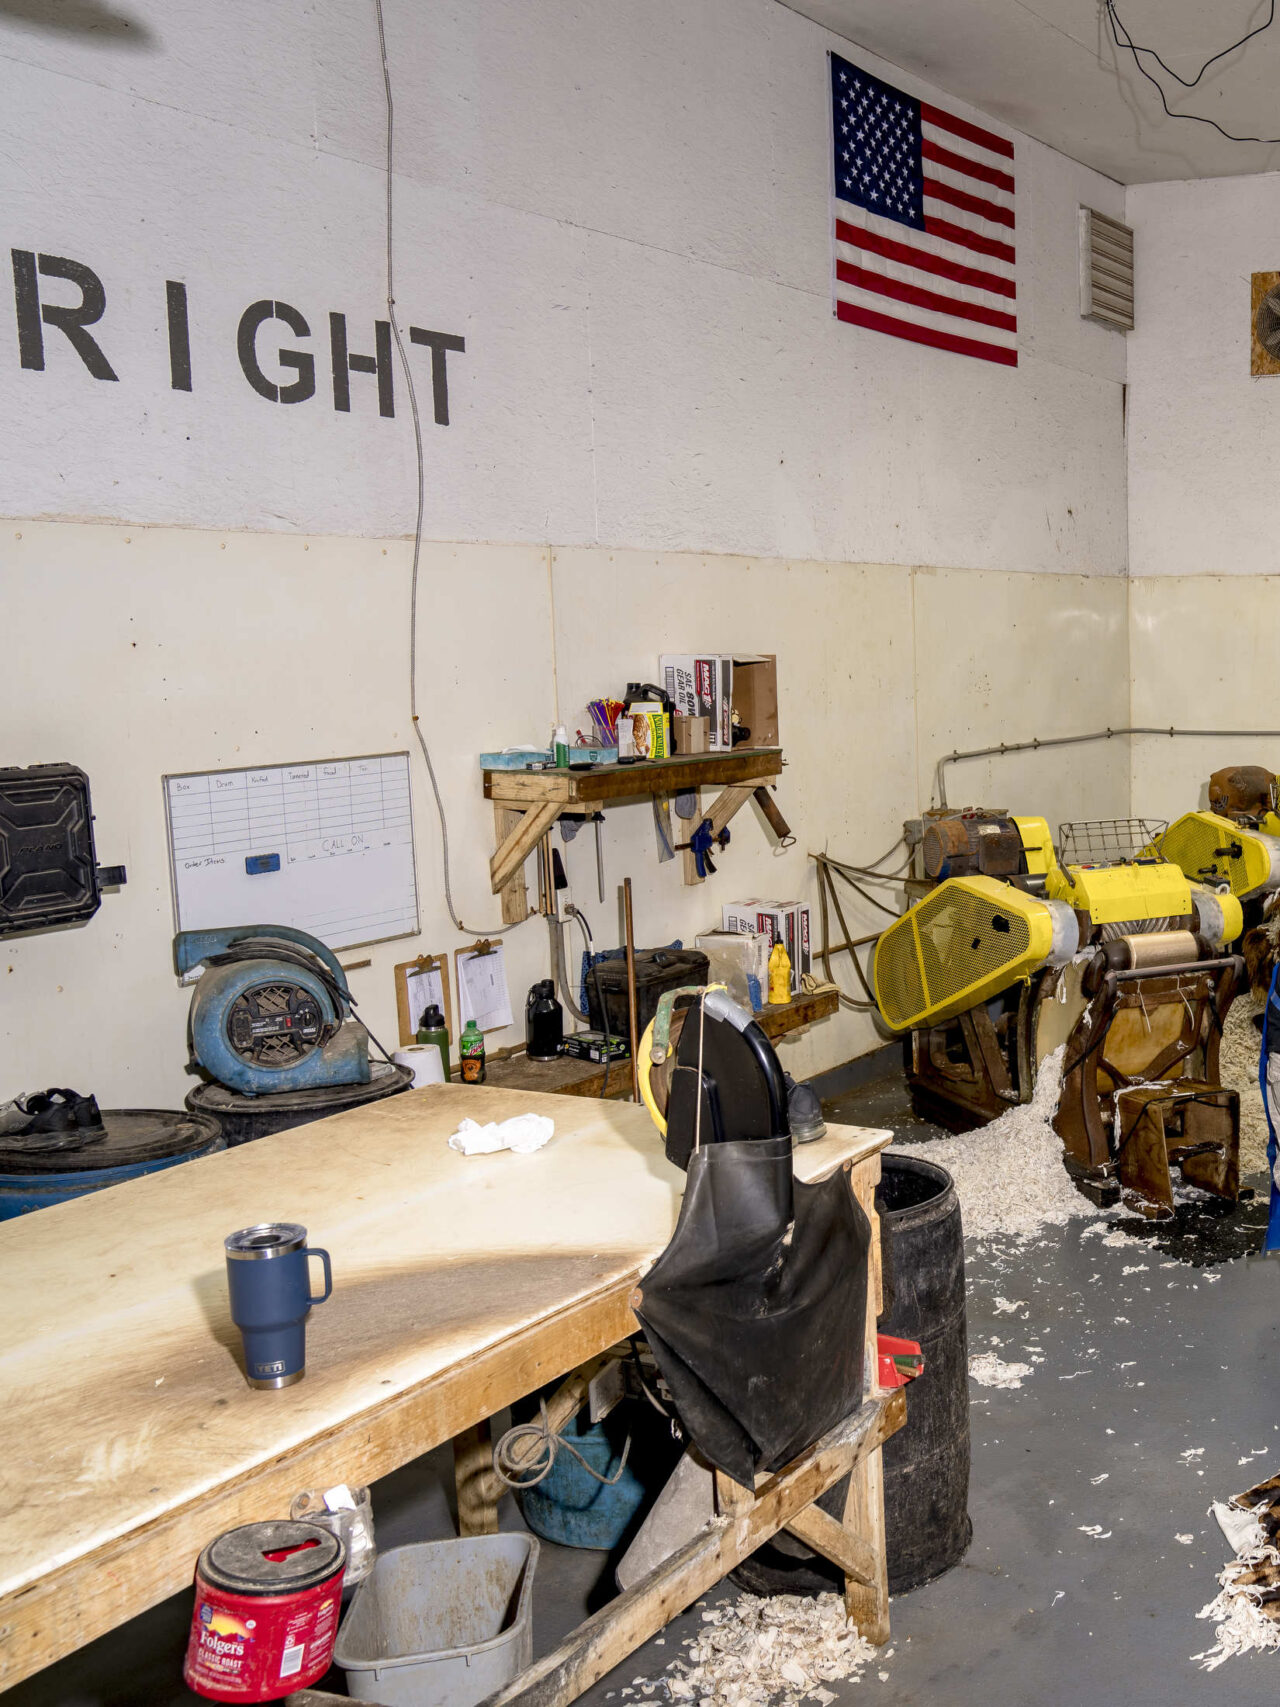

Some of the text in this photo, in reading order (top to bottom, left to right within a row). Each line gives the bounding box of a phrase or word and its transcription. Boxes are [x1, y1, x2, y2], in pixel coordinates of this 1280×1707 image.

[11, 248, 466, 427] RIGHT
[676, 668, 685, 690] GEAR
[684, 671, 693, 689] SAE
[678, 691, 686, 704] OIL
[653, 715, 664, 757] NATURE VALLEY
[176, 783, 191, 792] Box
[216, 780, 234, 788] Drum
[322, 839, 344, 851] CALL
[350, 834, 364, 846] ON
[257, 1363, 283, 1373] YETI
[200, 1629, 244, 1656] Folgers
[198, 1648, 243, 1669] CLASSIC ROAST
